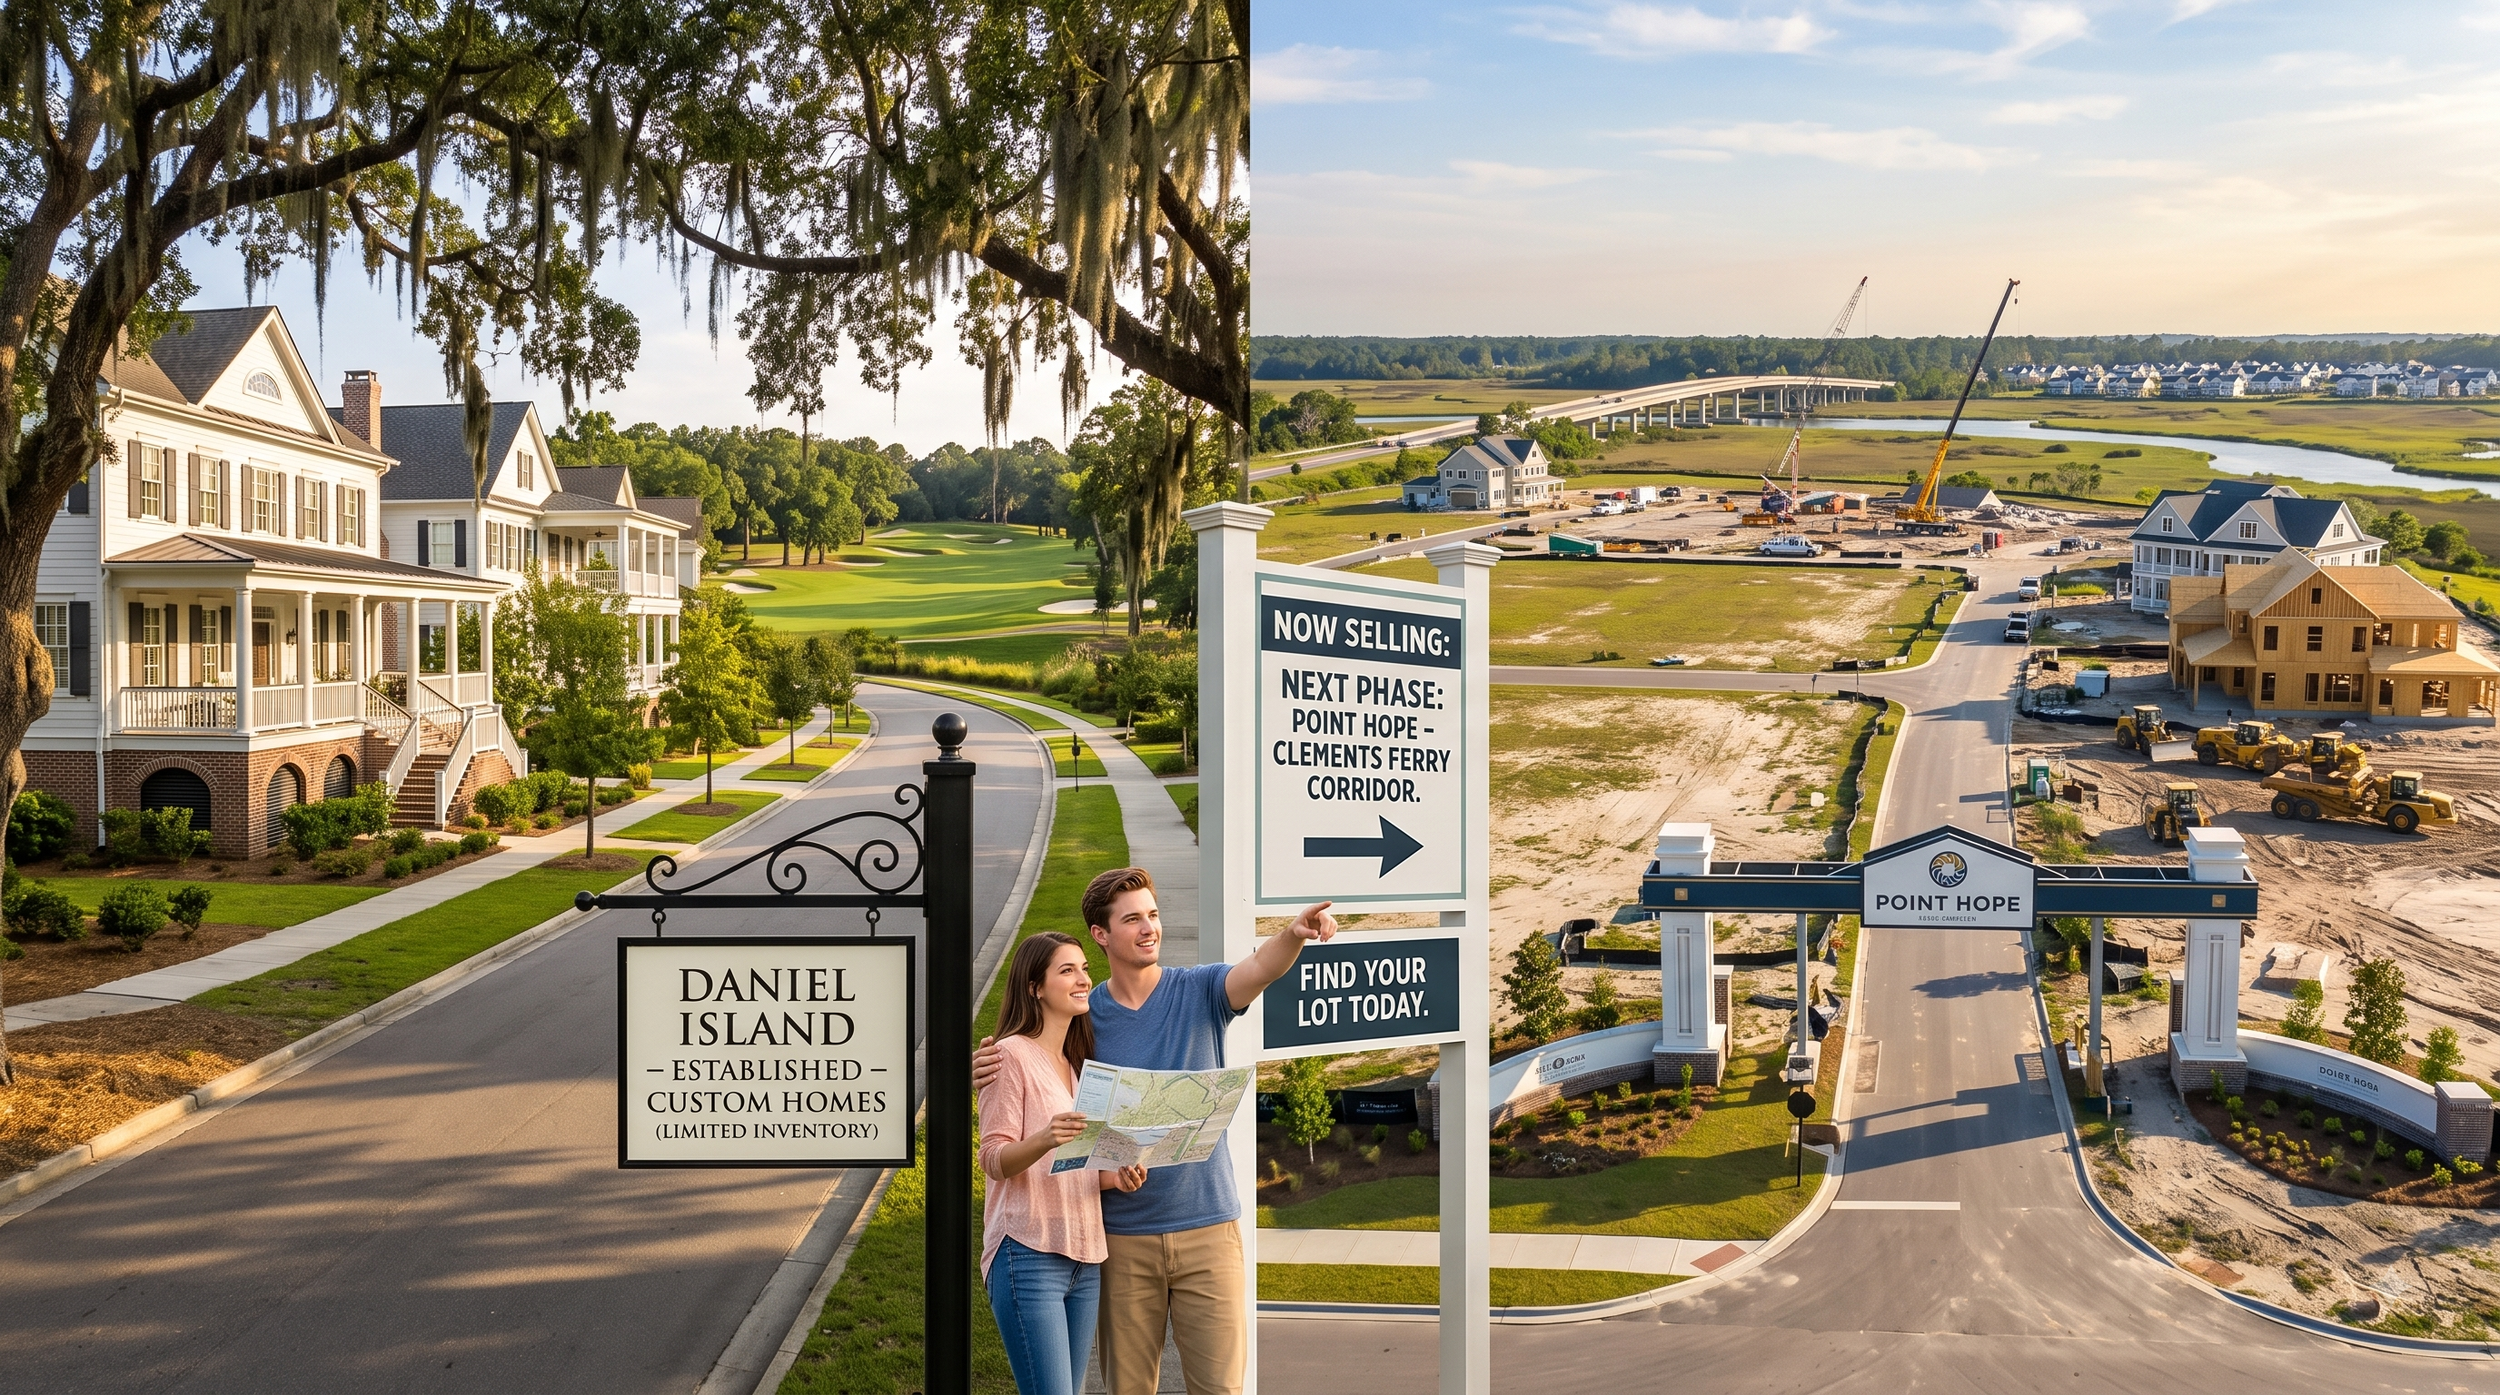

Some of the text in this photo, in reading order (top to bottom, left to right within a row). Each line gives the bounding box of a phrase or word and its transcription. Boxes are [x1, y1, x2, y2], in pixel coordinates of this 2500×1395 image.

[1273, 608, 1450, 657] NOW SELLING:
[1281, 668, 1444, 710] NEXT PHASE:
[1292, 708, 1357, 736] POINT
[1363, 712, 1418, 740] HOPE
[1272, 740, 1451, 773] CLEMENTS FERRY
[1306, 775, 1421, 803] CORRIDOR.
[1876, 894, 2021, 912] POINT HOPE
[678, 967, 856, 1003] DANIEL
[1300, 956, 1427, 992] FIND YOUR
[1298, 990, 1429, 1027] LOT TODAY.
[679, 1011, 856, 1046] ISLAND
[671, 1059, 862, 1081] ESTABLISHED
[647, 1090, 886, 1114] CUSTOM HOMES
[655, 1123, 879, 1141] (LIMITED INVENTORY)
